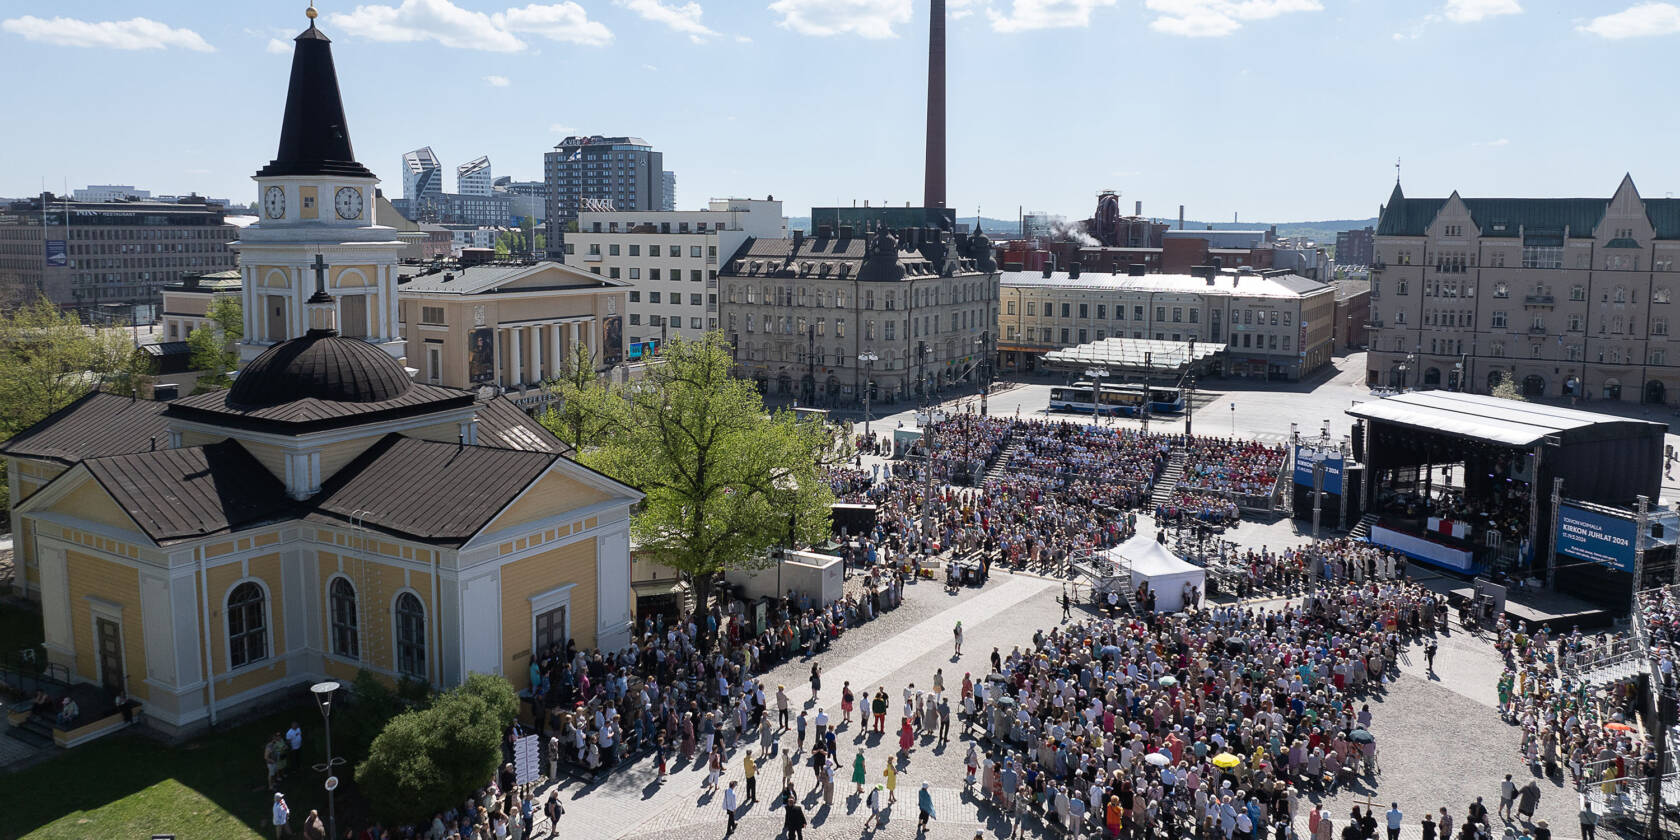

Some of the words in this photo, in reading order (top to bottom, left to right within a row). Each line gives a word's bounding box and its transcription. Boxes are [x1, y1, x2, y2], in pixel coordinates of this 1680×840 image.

[1562, 524, 1588, 536] KIRKON
[1588, 530, 1612, 542] JUHLAT
[1612, 536, 1629, 546] 2024
